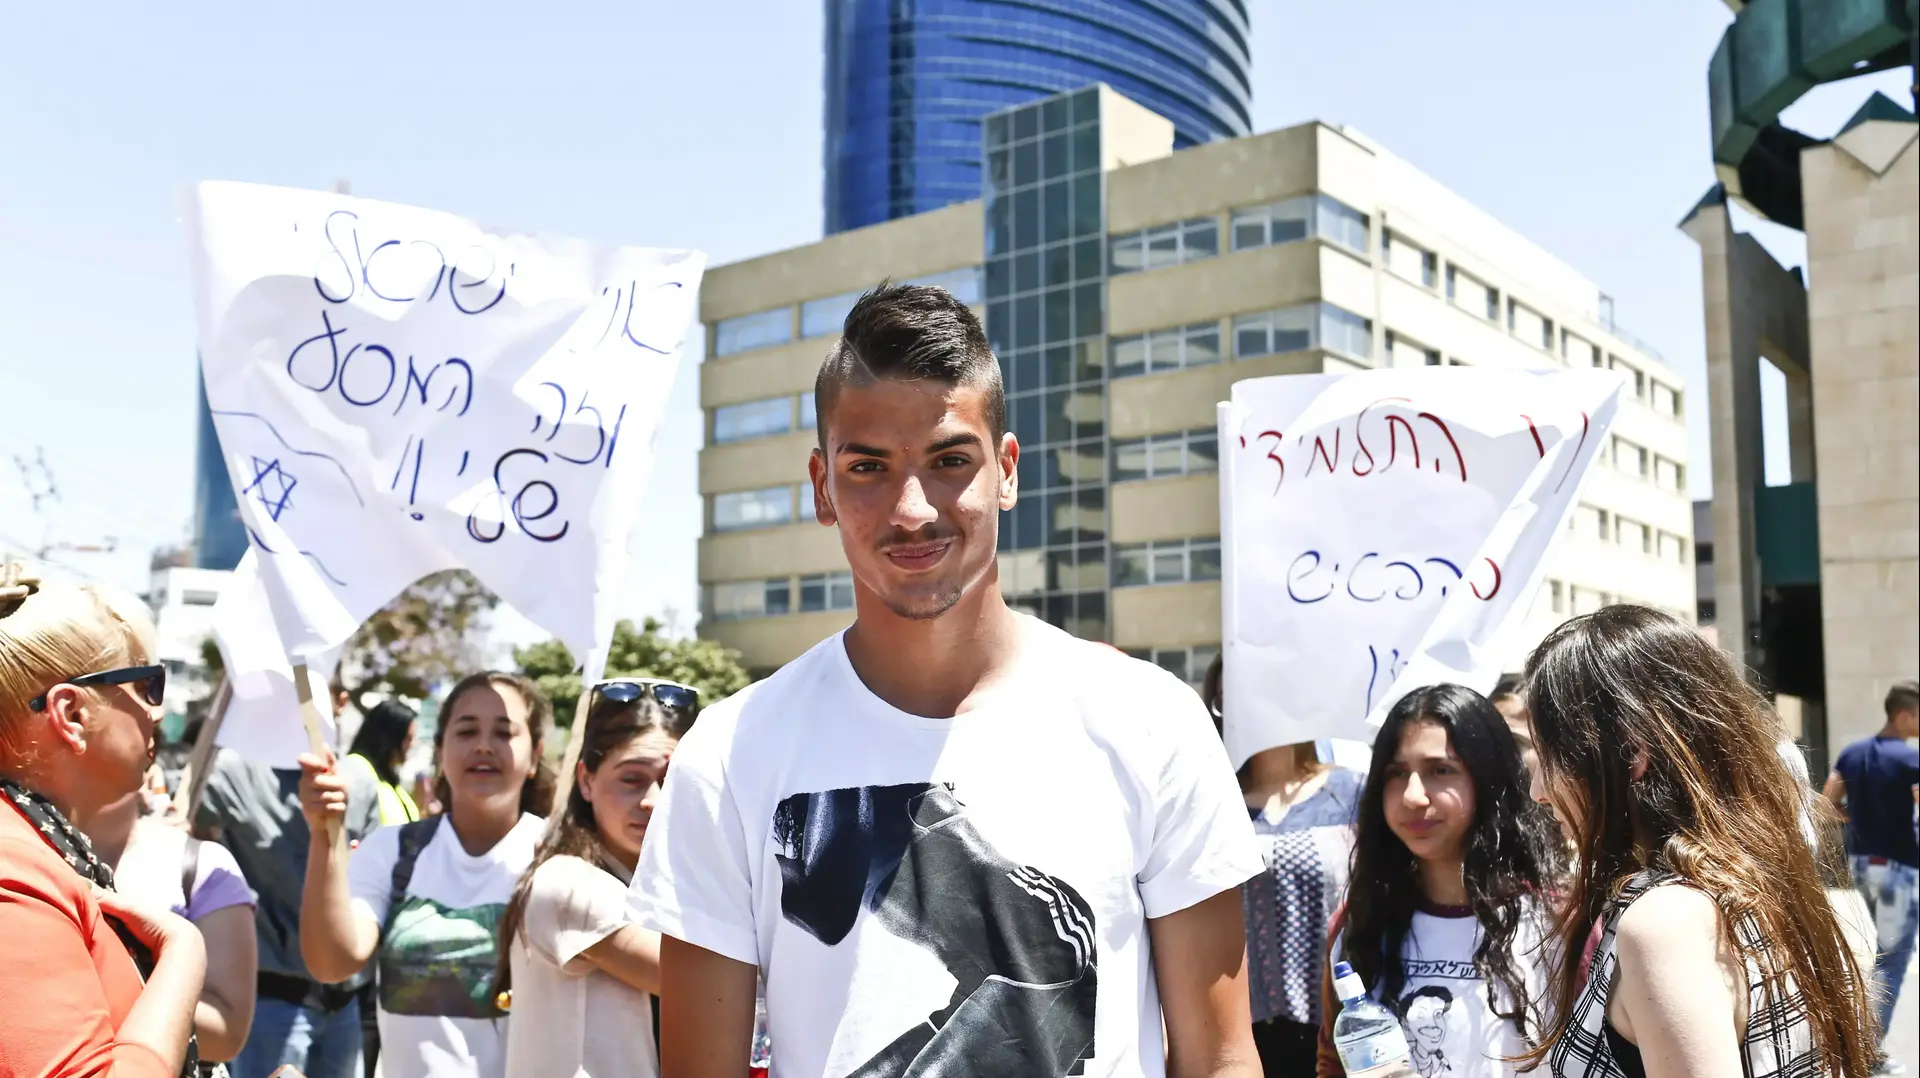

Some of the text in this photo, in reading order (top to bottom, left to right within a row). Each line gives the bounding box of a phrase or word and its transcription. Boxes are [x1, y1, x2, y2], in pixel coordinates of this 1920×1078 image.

[293, 209, 518, 315] ישראלי
[286, 309, 627, 468] וזה המסע
